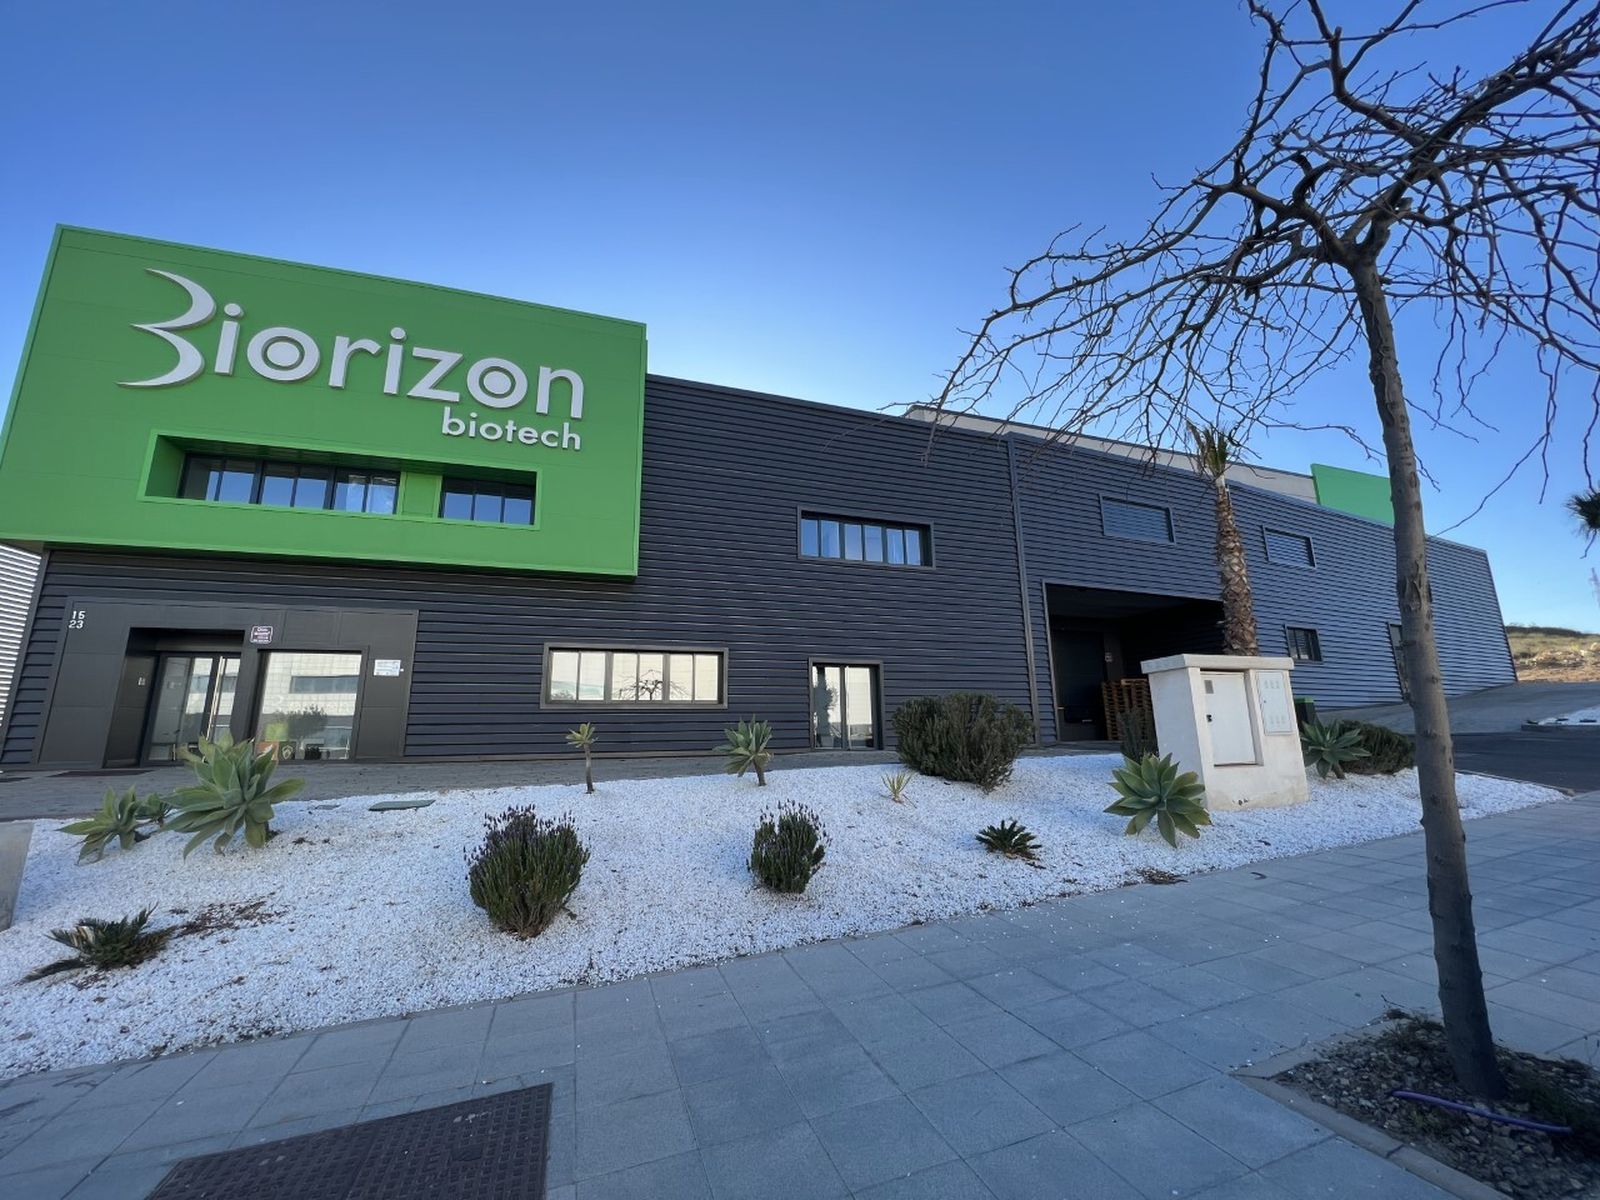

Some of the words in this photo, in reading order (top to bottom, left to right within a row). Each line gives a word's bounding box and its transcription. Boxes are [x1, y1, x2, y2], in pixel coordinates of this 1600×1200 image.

[115, 267, 585, 420] Biorizon
[441, 406, 582, 450] biotech
[68, 619, 84, 629] 23
